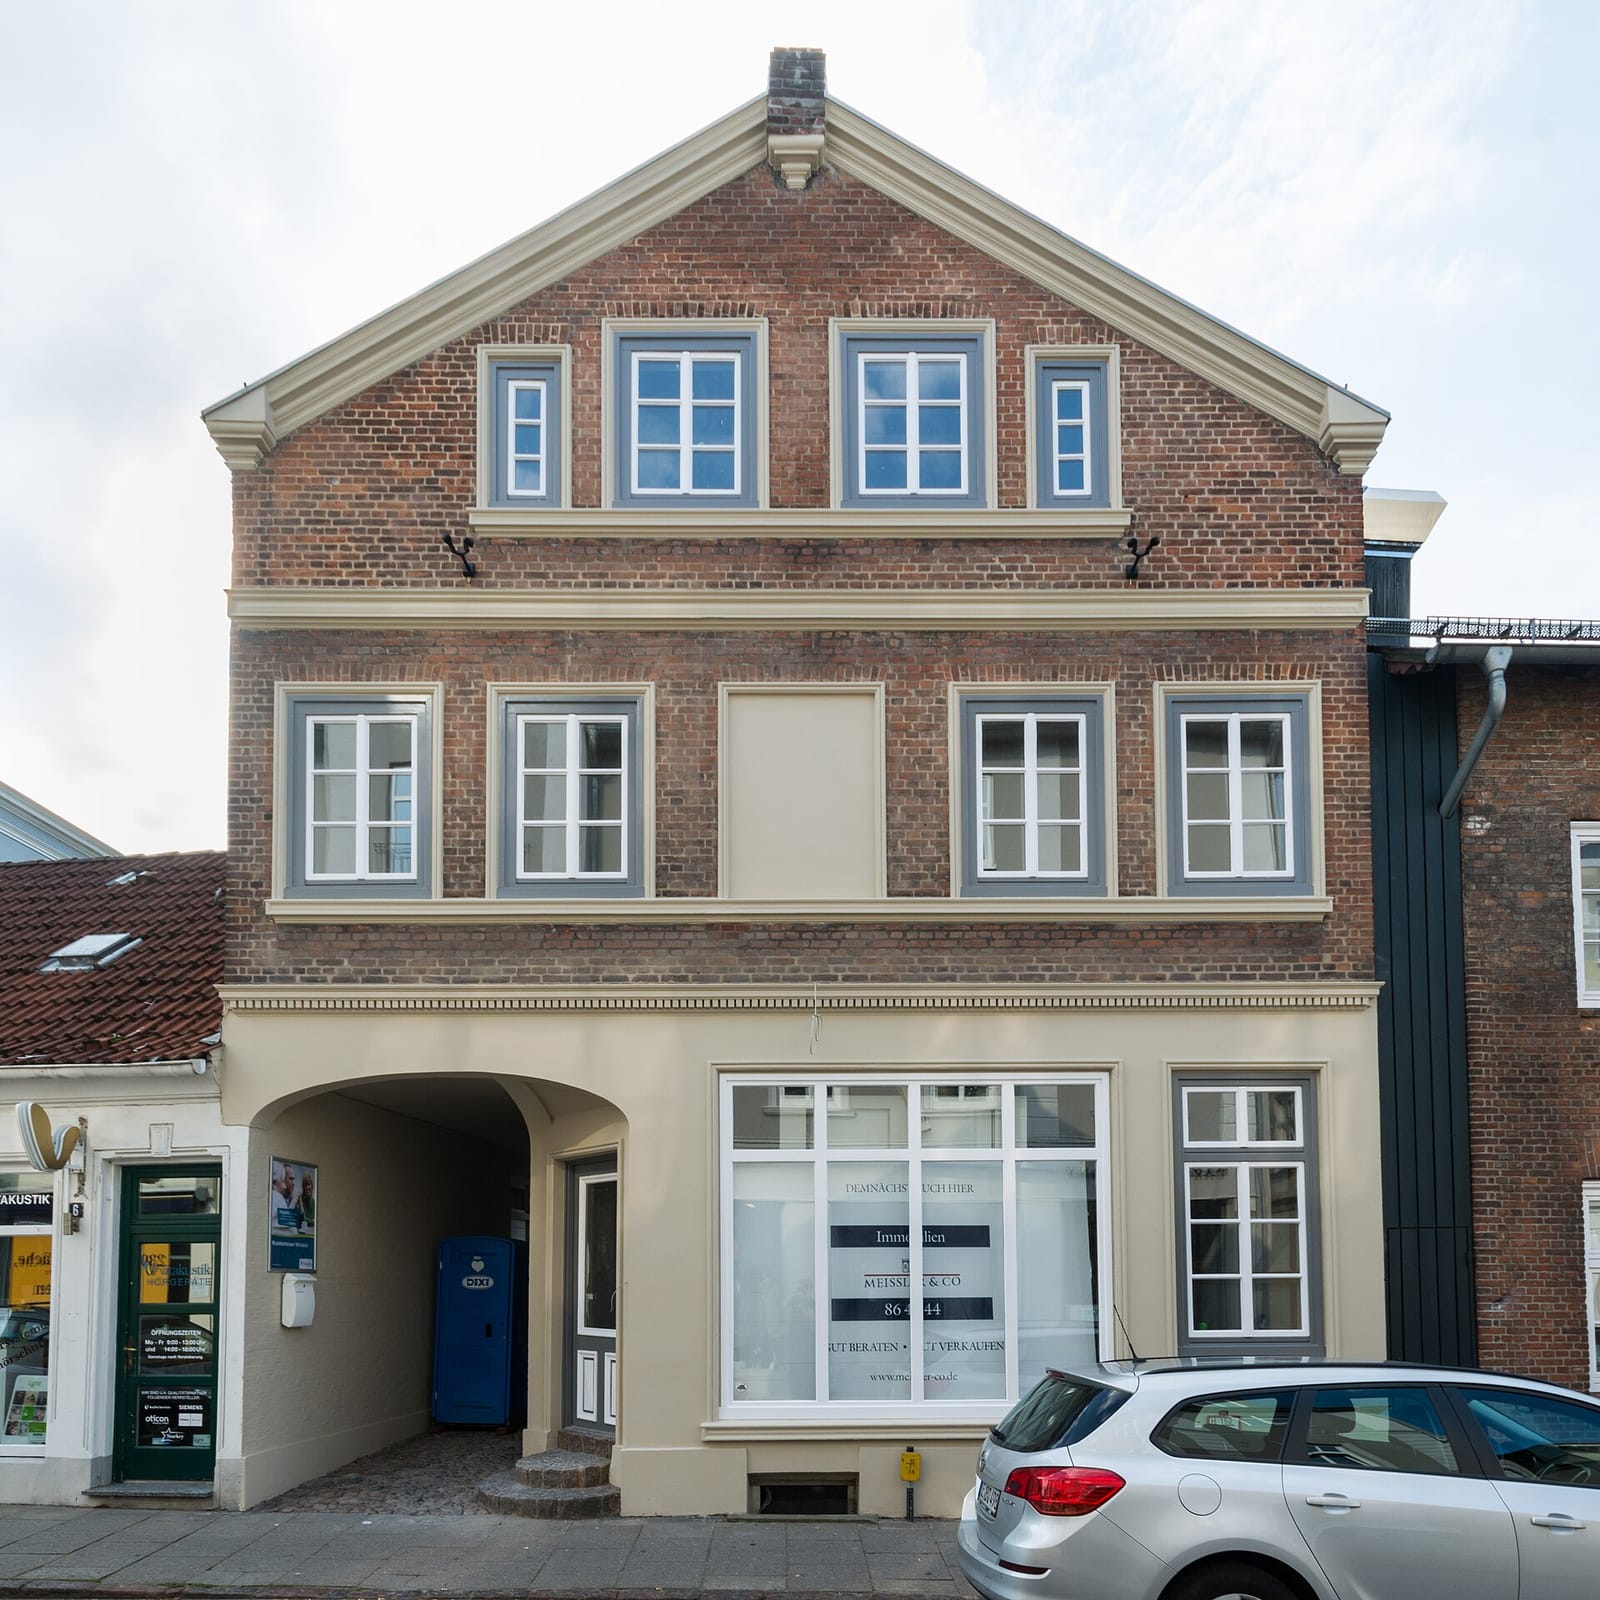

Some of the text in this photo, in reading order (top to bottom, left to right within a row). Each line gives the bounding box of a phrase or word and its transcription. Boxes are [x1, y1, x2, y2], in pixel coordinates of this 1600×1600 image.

[846, 1183, 975, 1193] DEMNÄCHS UCH HIER
[0, 1194, 50, 1205] AKUSTIK
[72, 1204, 79, 1217] 6
[876, 1231, 946, 1243] Immlien
[864, 1276, 961, 1288] MEISSL & CO
[884, 1303, 902, 1316] 86
[924, 1303, 942, 1316] 44
[849, 1342, 899, 1352] BERATEN
[938, 1341, 1005, 1351] VERKAUFEN
